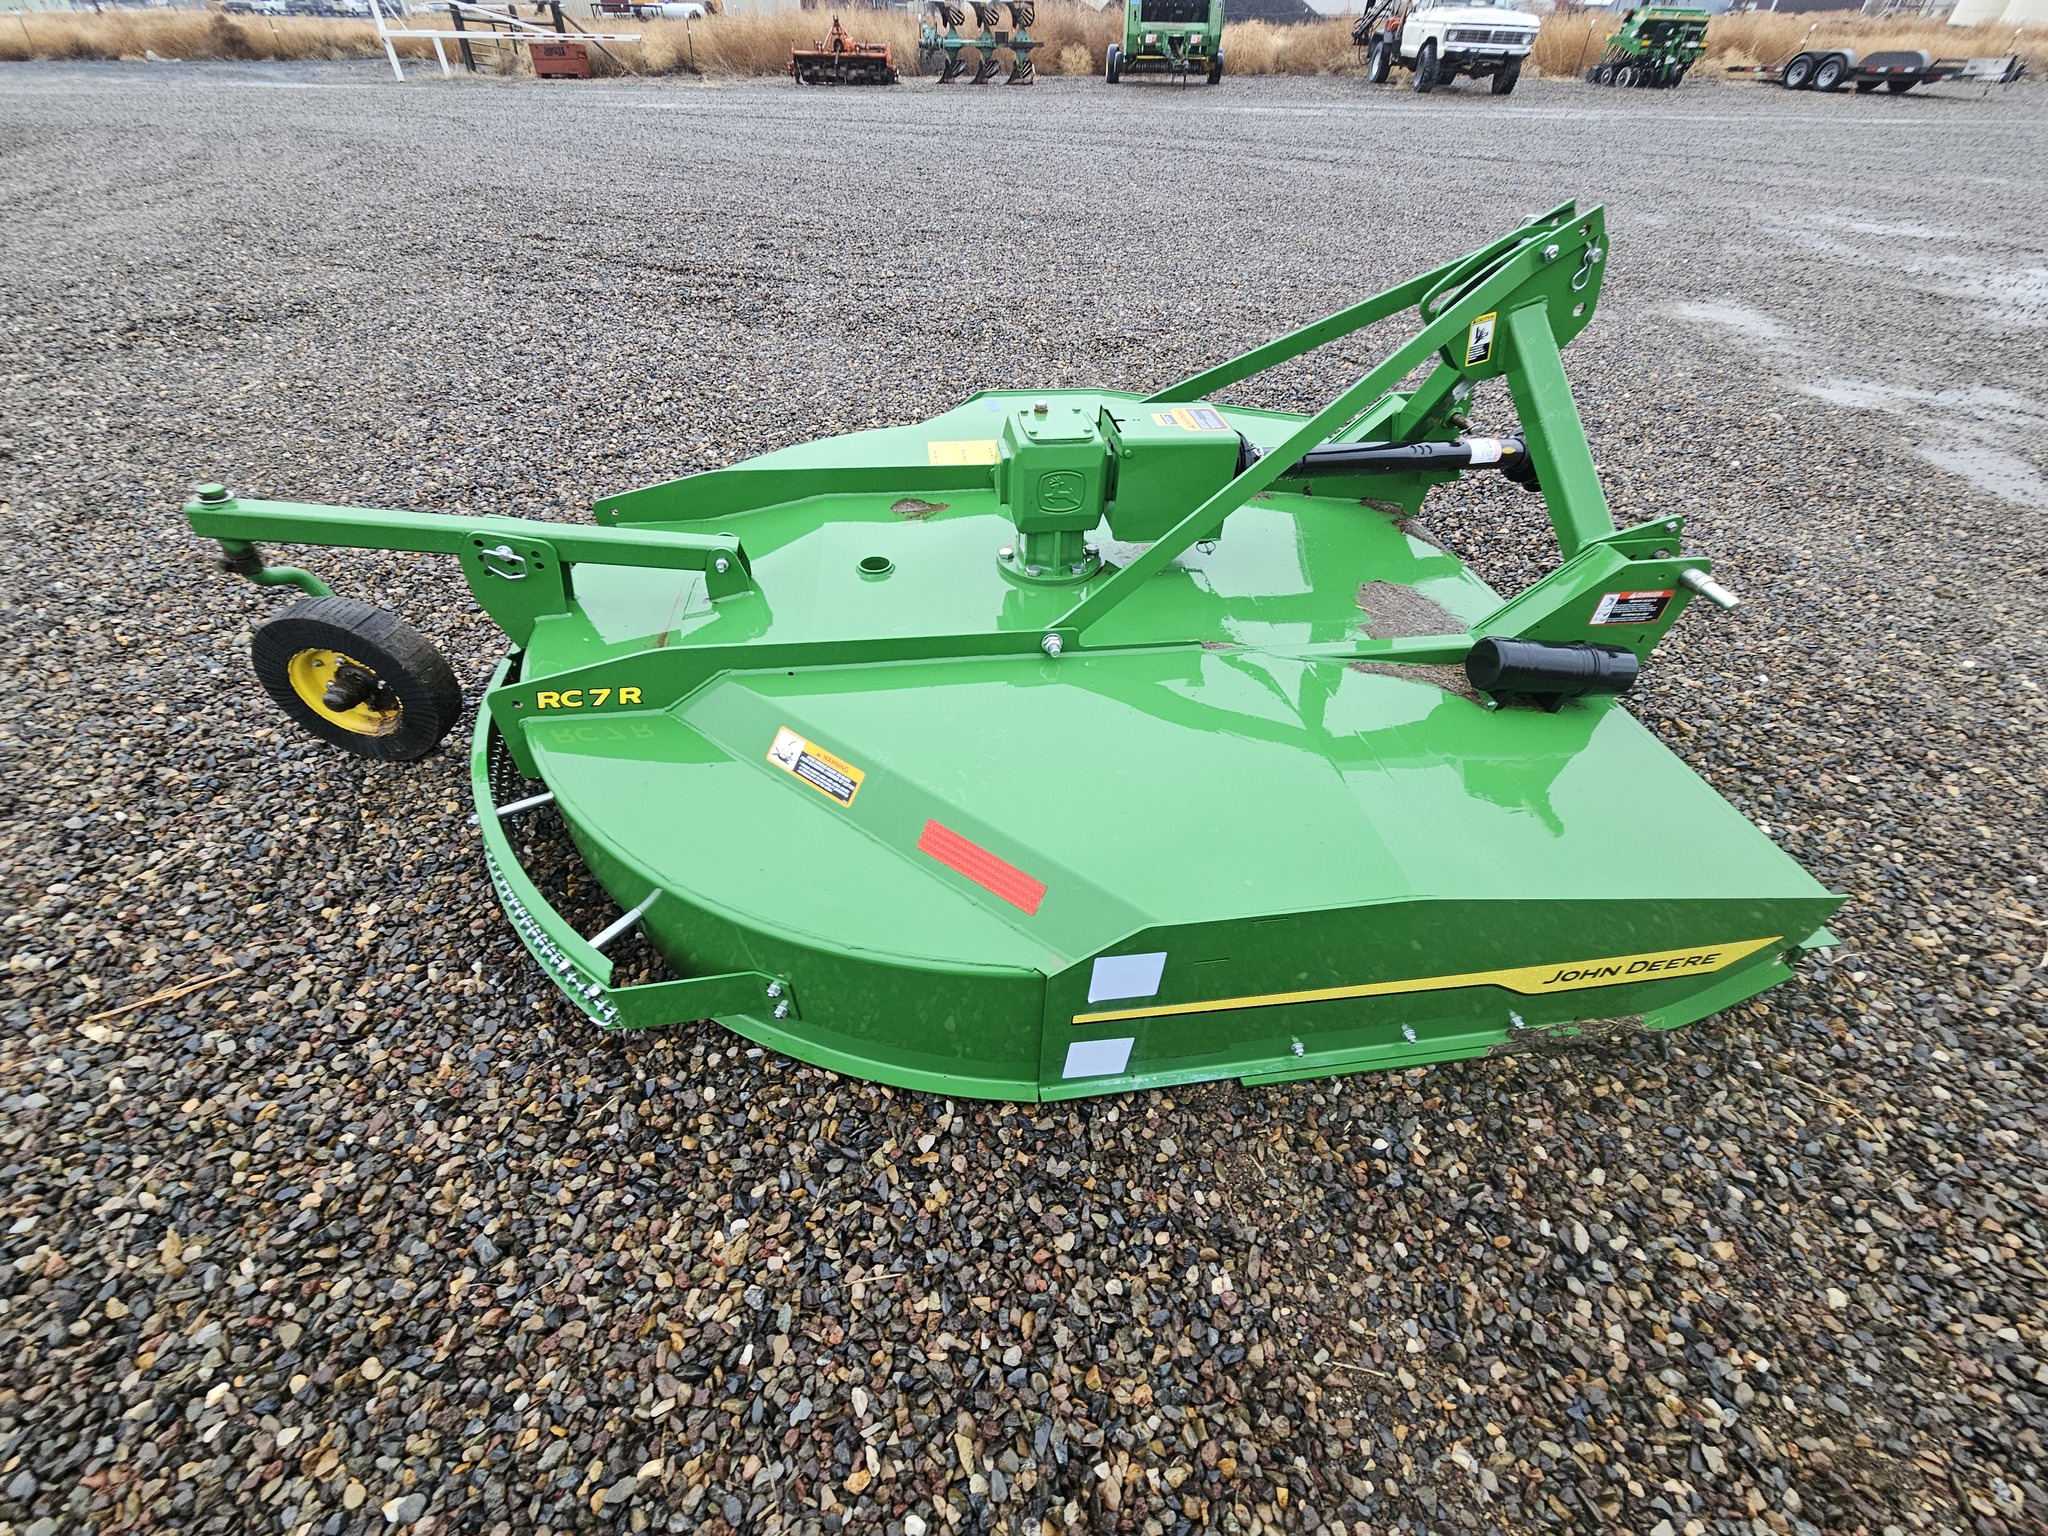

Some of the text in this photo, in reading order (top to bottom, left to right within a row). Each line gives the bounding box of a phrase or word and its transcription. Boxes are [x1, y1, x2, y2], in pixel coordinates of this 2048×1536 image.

[537, 686, 643, 709] RC 7 R
[1542, 953, 1722, 985] JOHN DEERE
